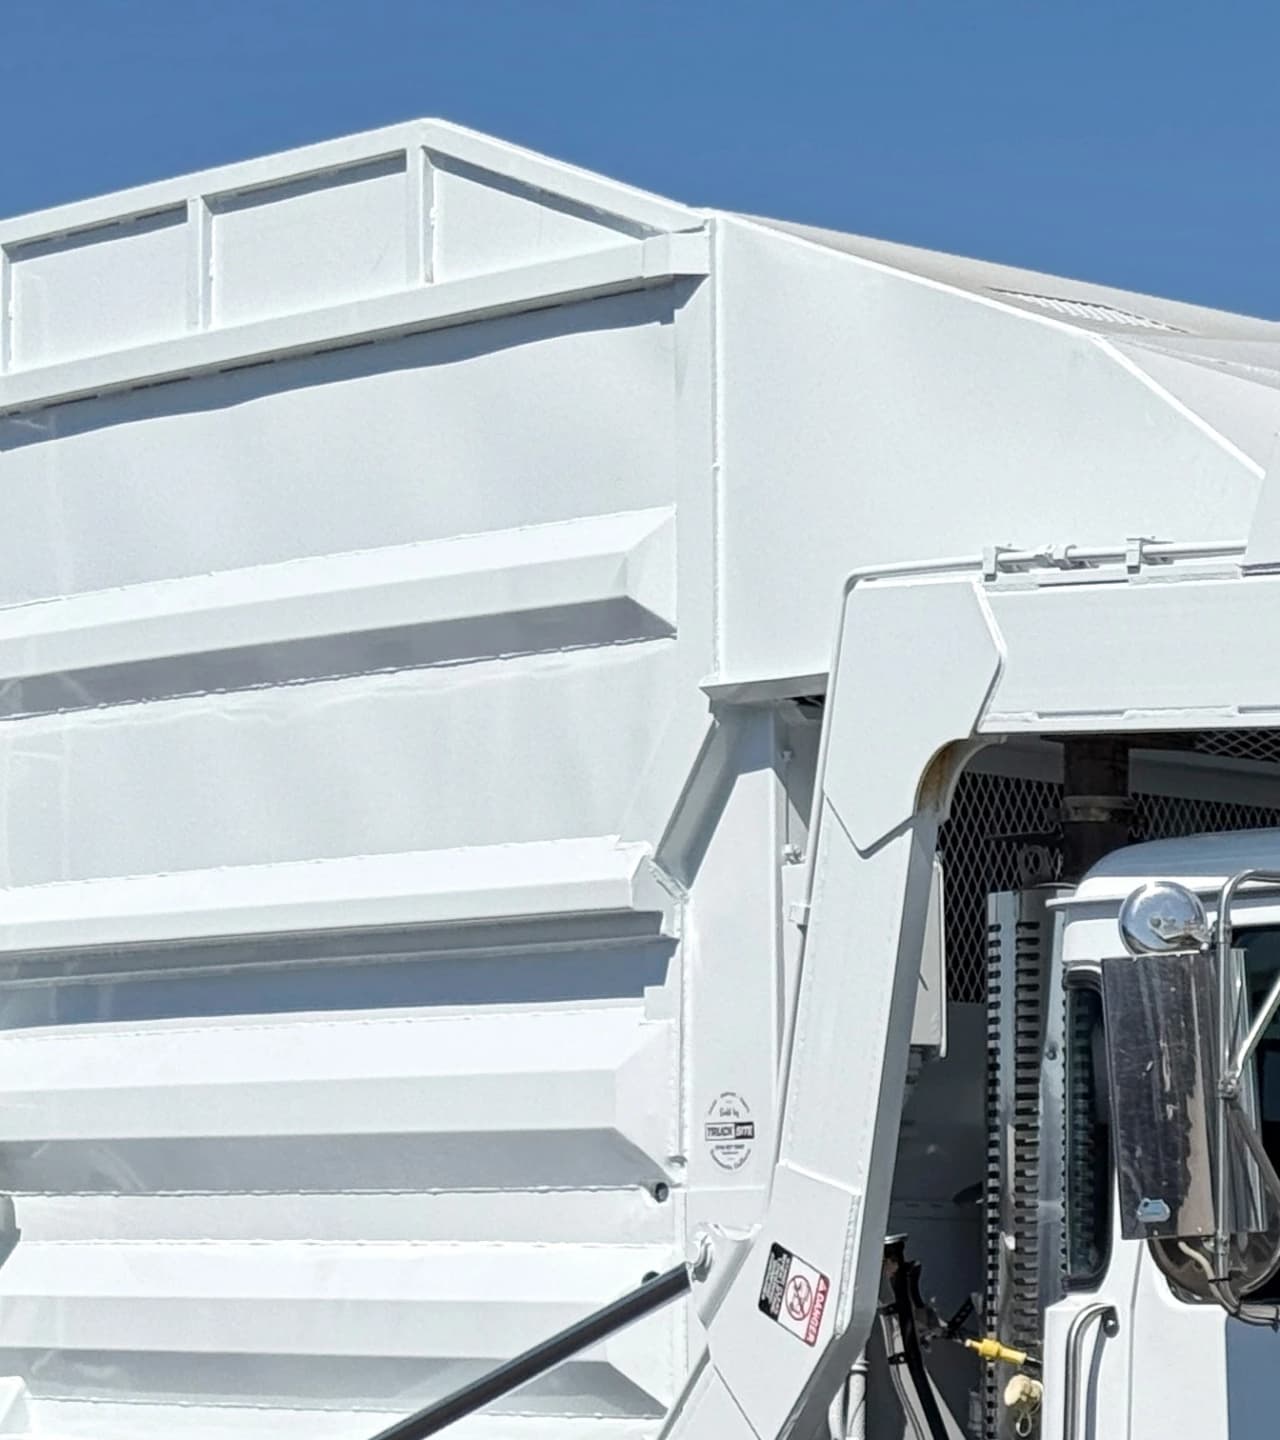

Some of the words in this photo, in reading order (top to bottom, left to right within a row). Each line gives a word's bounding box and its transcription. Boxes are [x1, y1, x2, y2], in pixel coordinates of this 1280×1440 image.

[707, 1126, 733, 1137] TRUCK
[735, 1125, 753, 1137] SITE
[806, 1294, 826, 1342] DANGER
